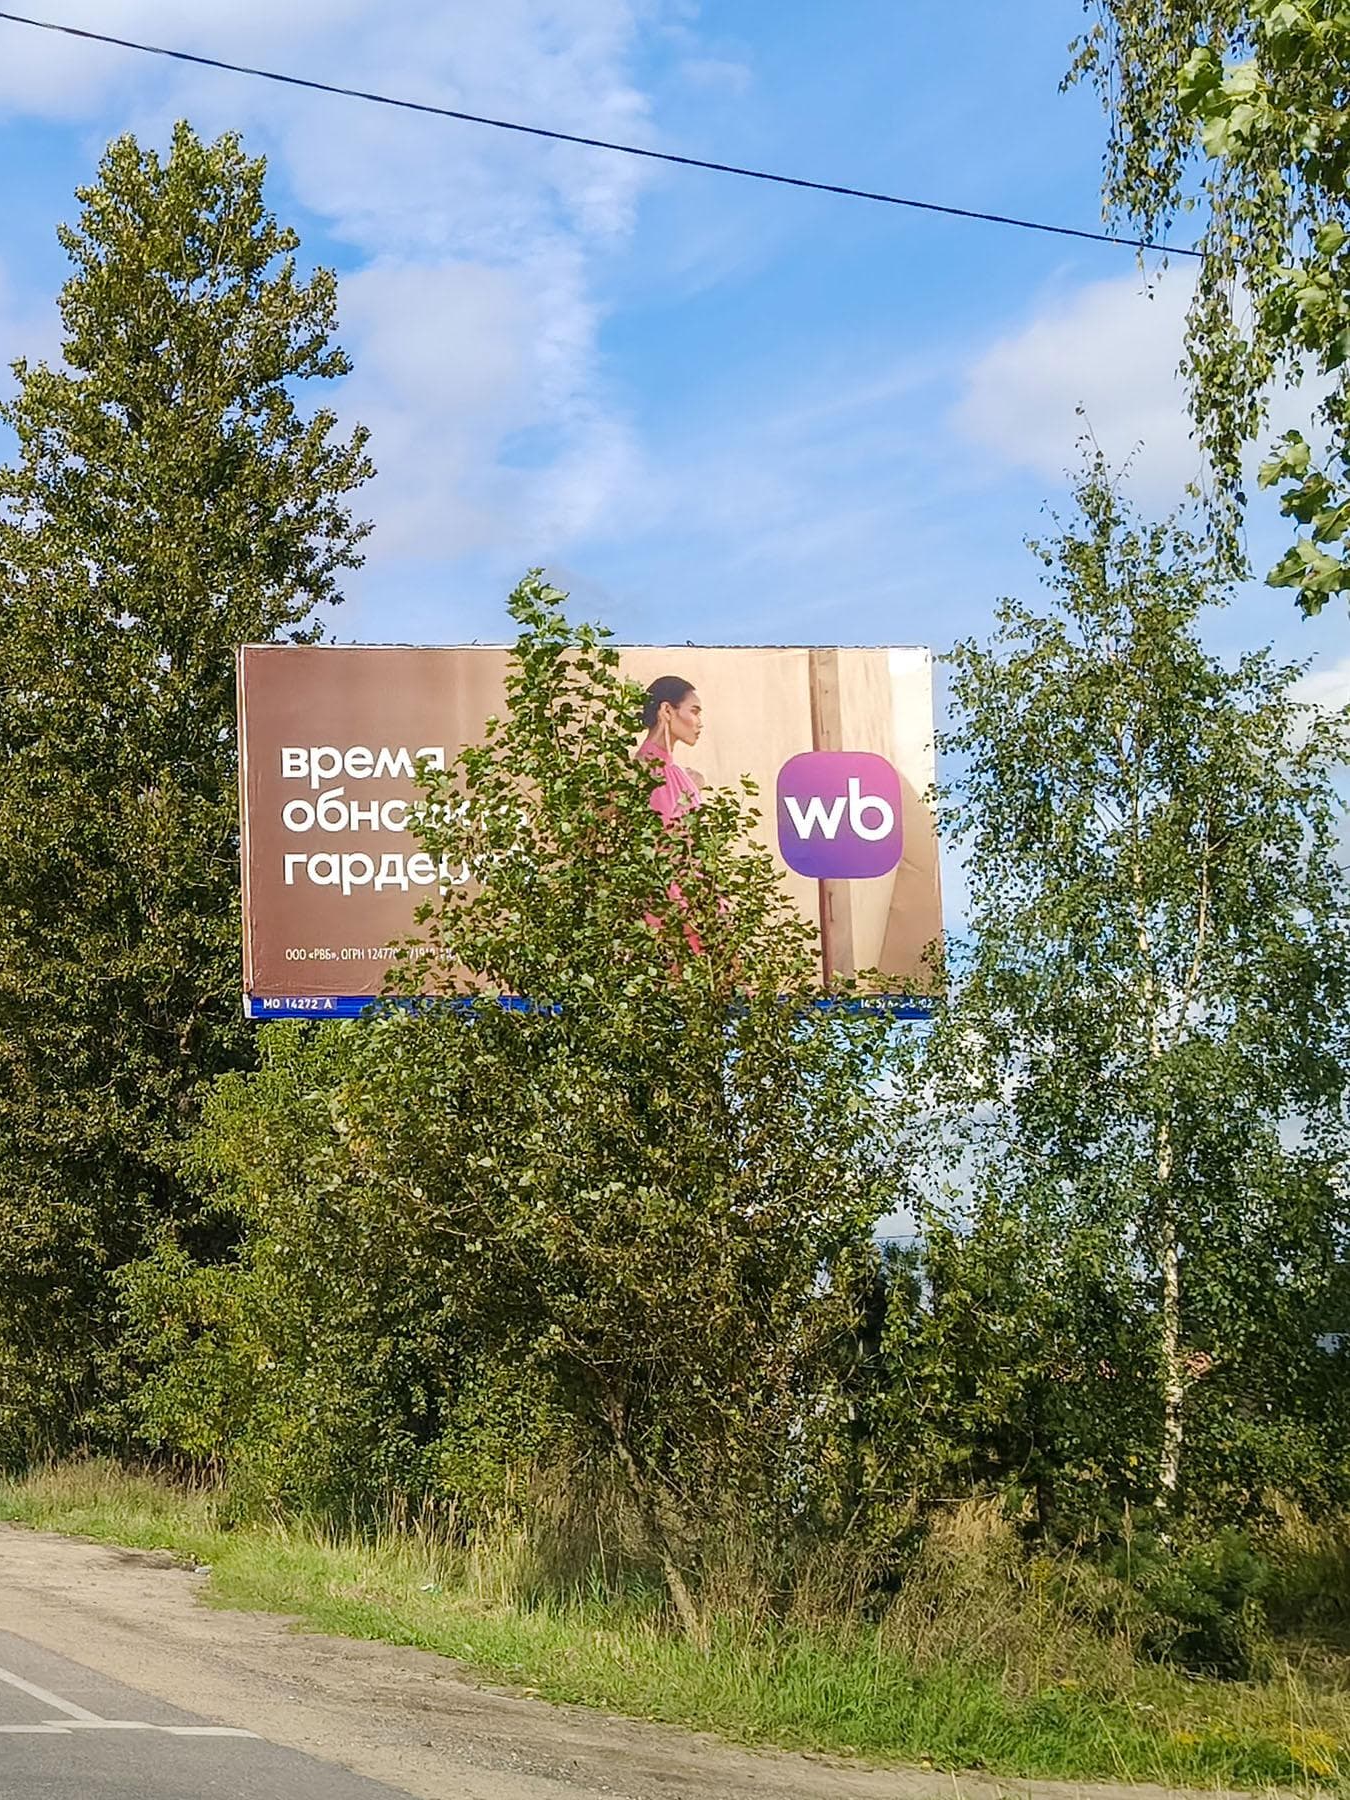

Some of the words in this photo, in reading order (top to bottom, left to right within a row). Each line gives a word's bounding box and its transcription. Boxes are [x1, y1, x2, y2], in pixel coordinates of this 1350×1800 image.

[281, 746, 445, 790] время
[783, 777, 895, 842] wb
[283, 843, 538, 896] гардер
[285, 948, 307, 961] ООО
[340, 948, 365, 961] ОГРН
[262, 998, 281, 1009] МО
[284, 998, 319, 1010] 14272
[323, 998, 333, 1009] А
